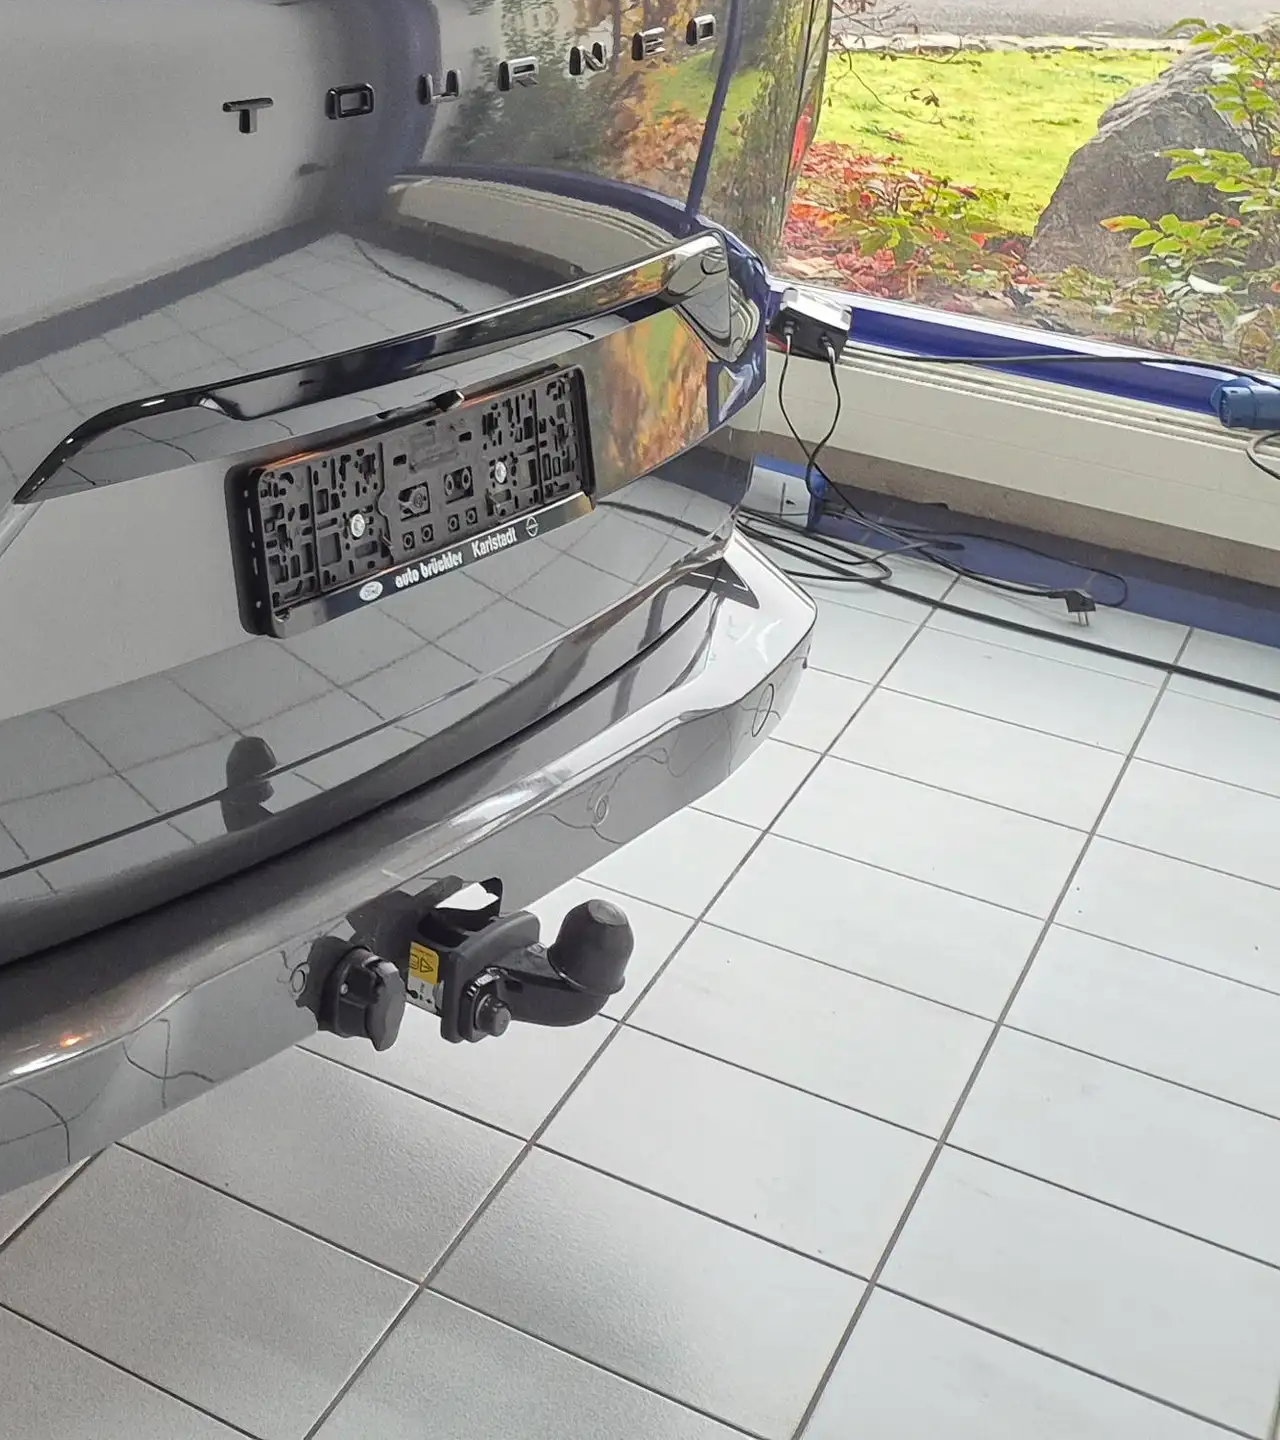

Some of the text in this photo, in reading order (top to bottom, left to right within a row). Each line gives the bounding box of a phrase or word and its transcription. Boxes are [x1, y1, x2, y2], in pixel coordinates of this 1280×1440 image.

[222, 13, 717, 135] TOURNEO
[395, 567, 420, 590] auto
[420, 551, 463, 580] brückler
[471, 527, 518, 558] Karlstadt
